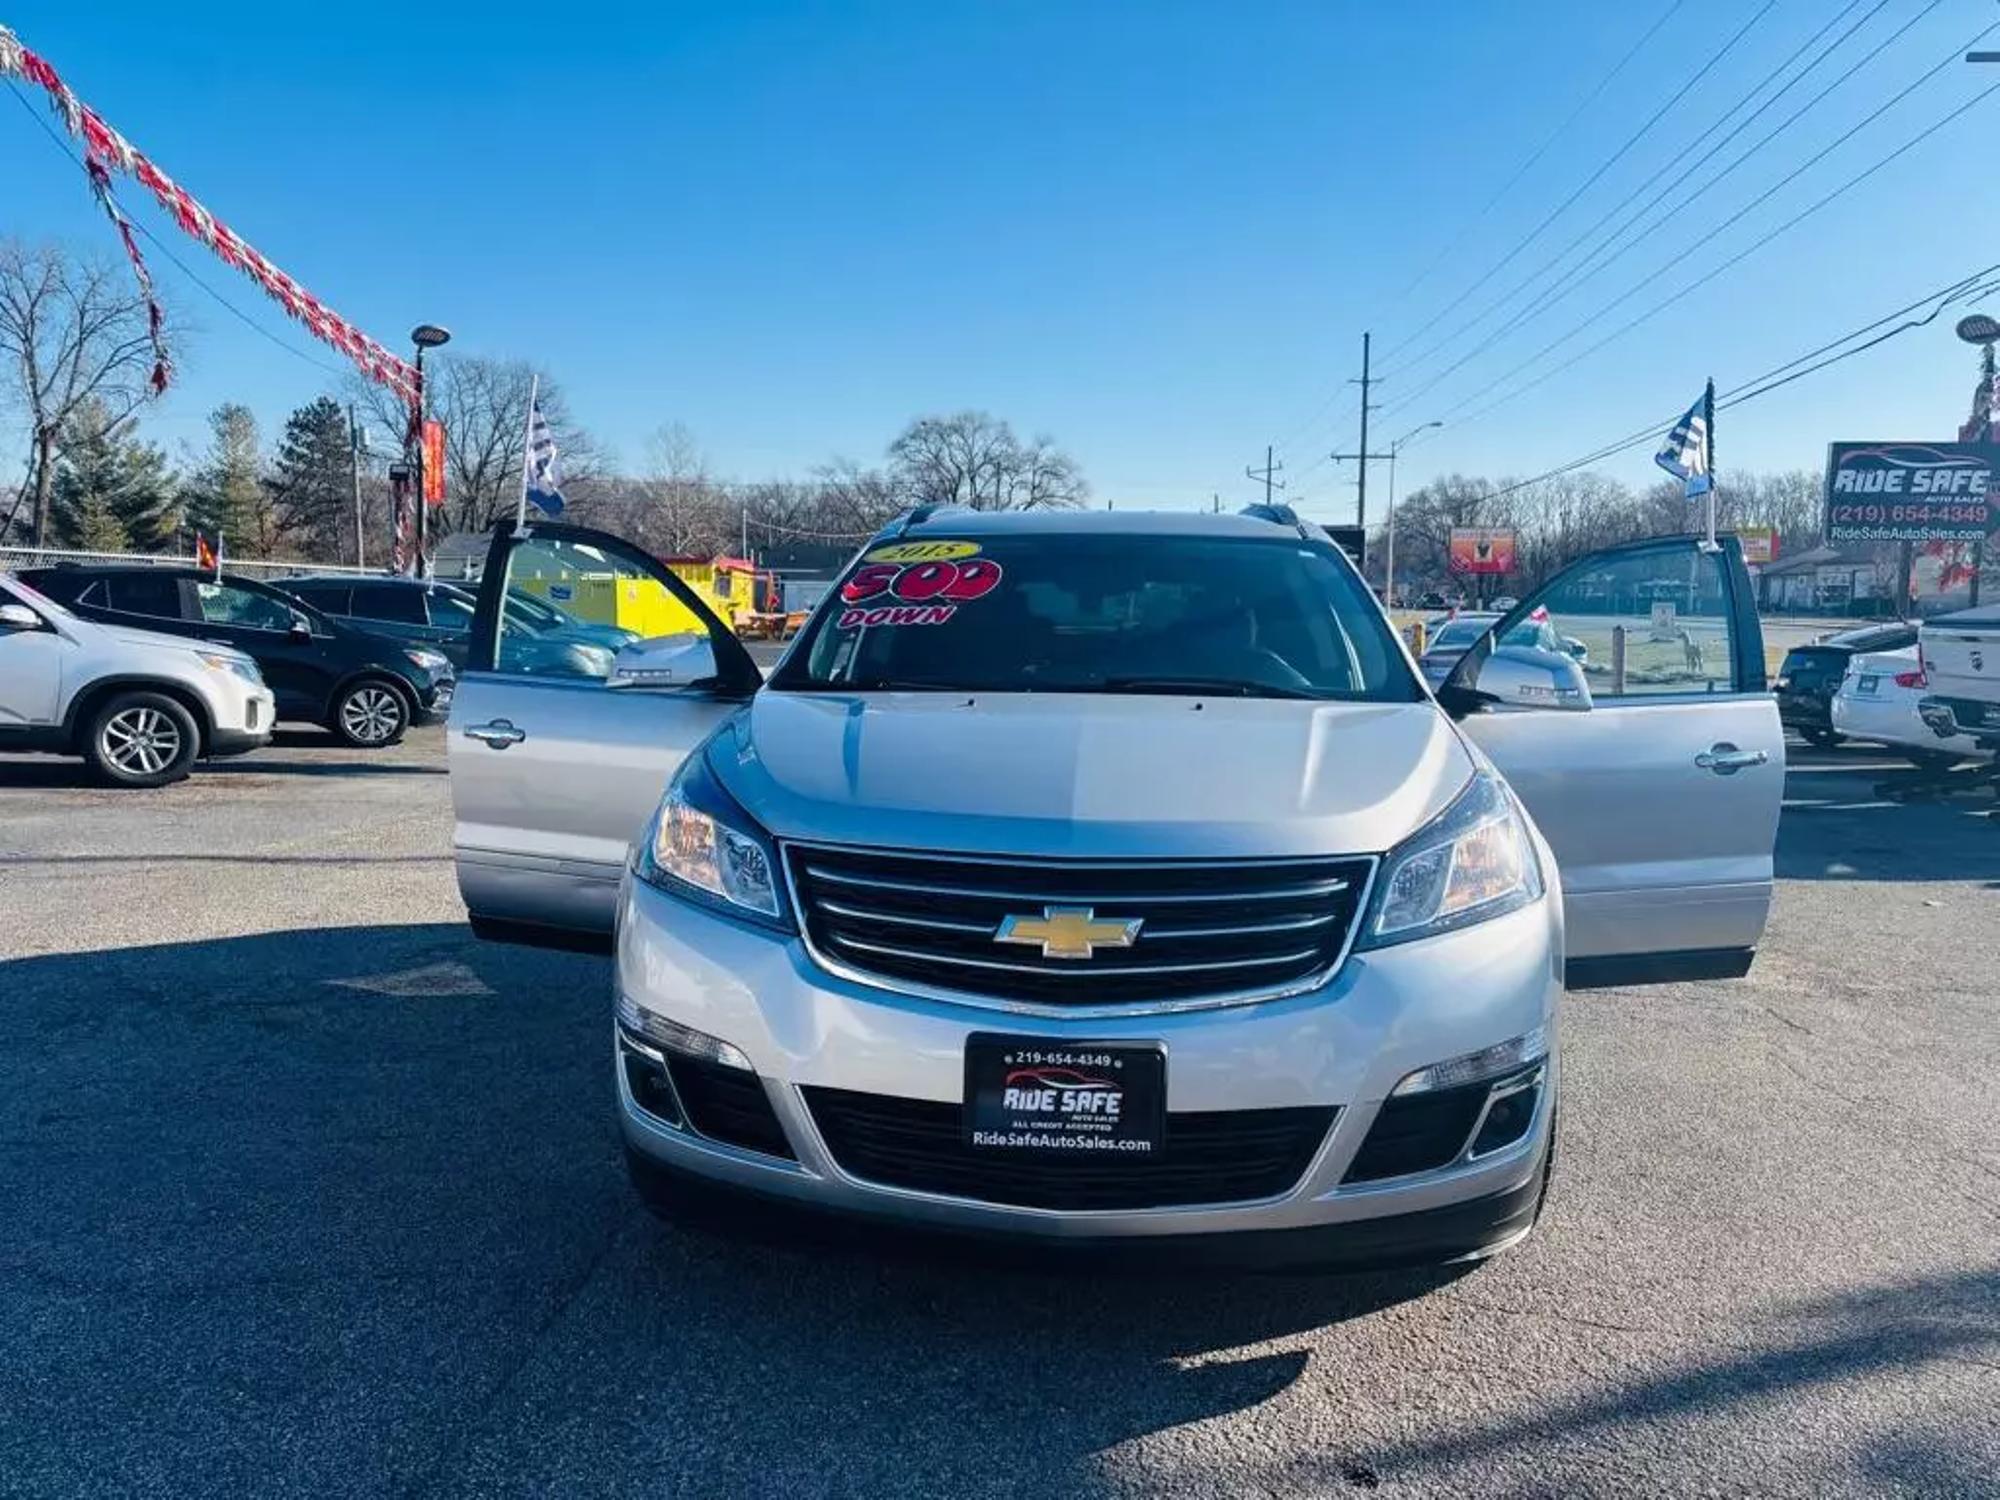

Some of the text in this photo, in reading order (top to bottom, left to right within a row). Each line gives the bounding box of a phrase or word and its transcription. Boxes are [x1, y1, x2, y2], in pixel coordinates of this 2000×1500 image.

[1834, 469, 1991, 494] RIDE SAFE
[1831, 505, 1988, 524] (219) 654-4349
[1831, 526, 1985, 540] RideSafeAutoSales.com
[840, 557, 1003, 604] 500
[836, 605, 958, 629] DOWN
[1016, 1051, 1111, 1067] 219-654-4349
[1003, 1088, 1123, 1113] RIDE SAFE
[1012, 1120, 1030, 1129] ALL
[973, 1131, 1151, 1151] RideSafeAutoSales.com
